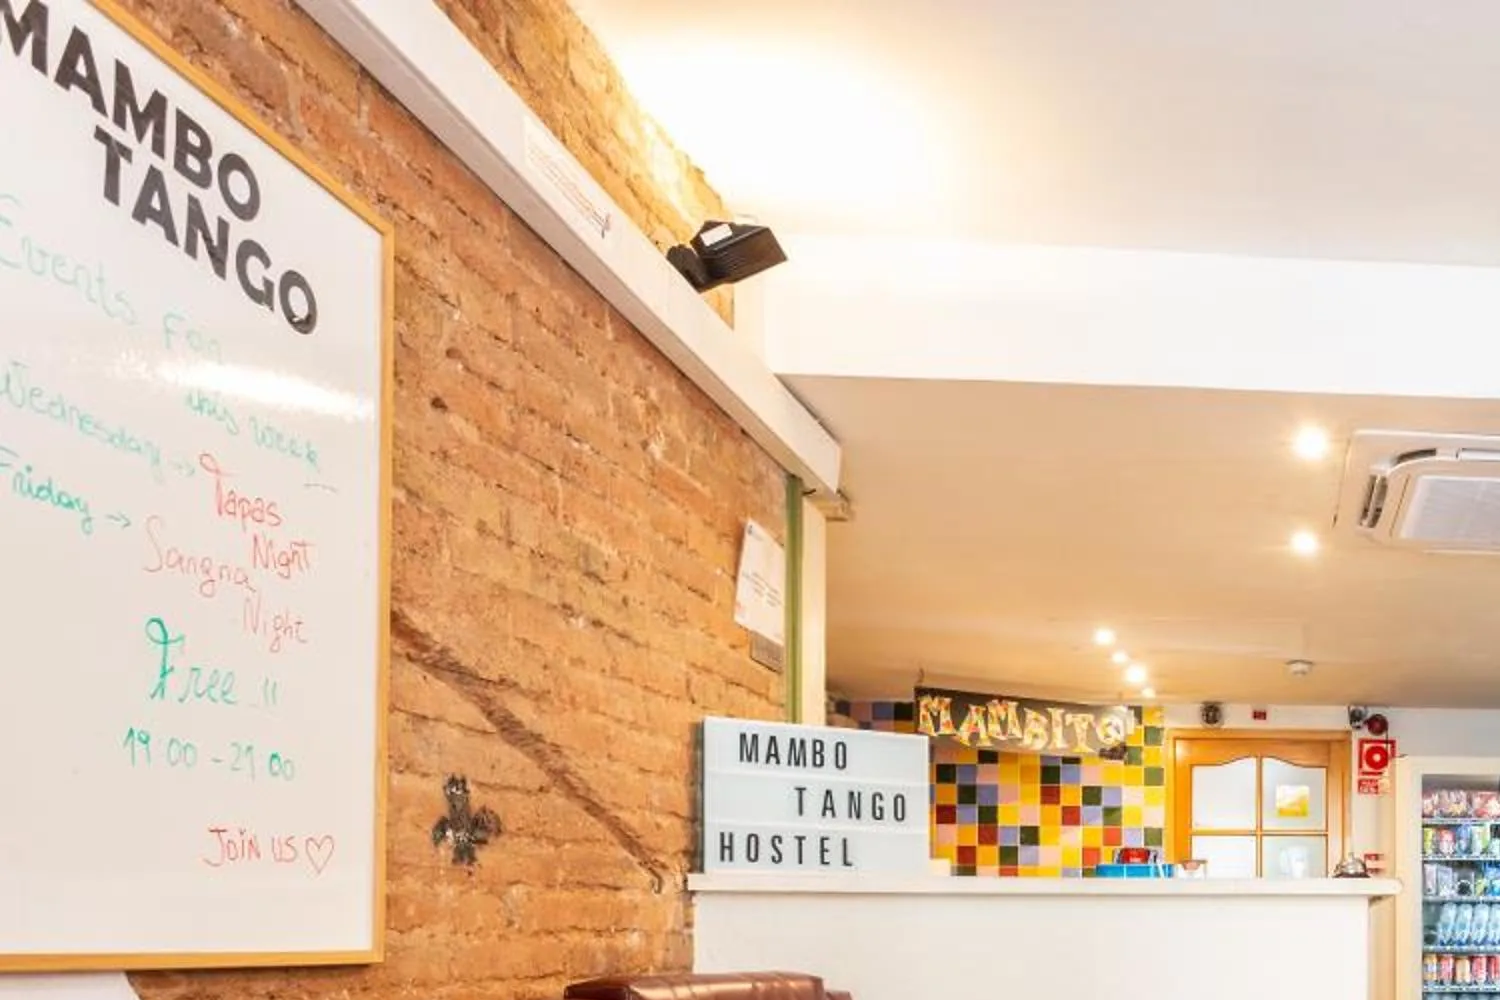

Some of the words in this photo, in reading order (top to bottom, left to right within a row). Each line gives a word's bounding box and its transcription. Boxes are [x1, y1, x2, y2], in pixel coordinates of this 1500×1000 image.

[0, 0, 260, 222] MAMBO
[94, 125, 317, 335] TANGO
[199, 453, 283, 532] Tapas
[252, 532, 315, 580] Night
[243, 590, 308, 654] Night
[145, 617, 238, 704] Free
[738, 732, 848, 771] MAMBO
[917, 694, 1128, 755] MAMBITO
[794, 786, 906, 823] TANGO
[718, 831, 855, 868] HOSTEL
